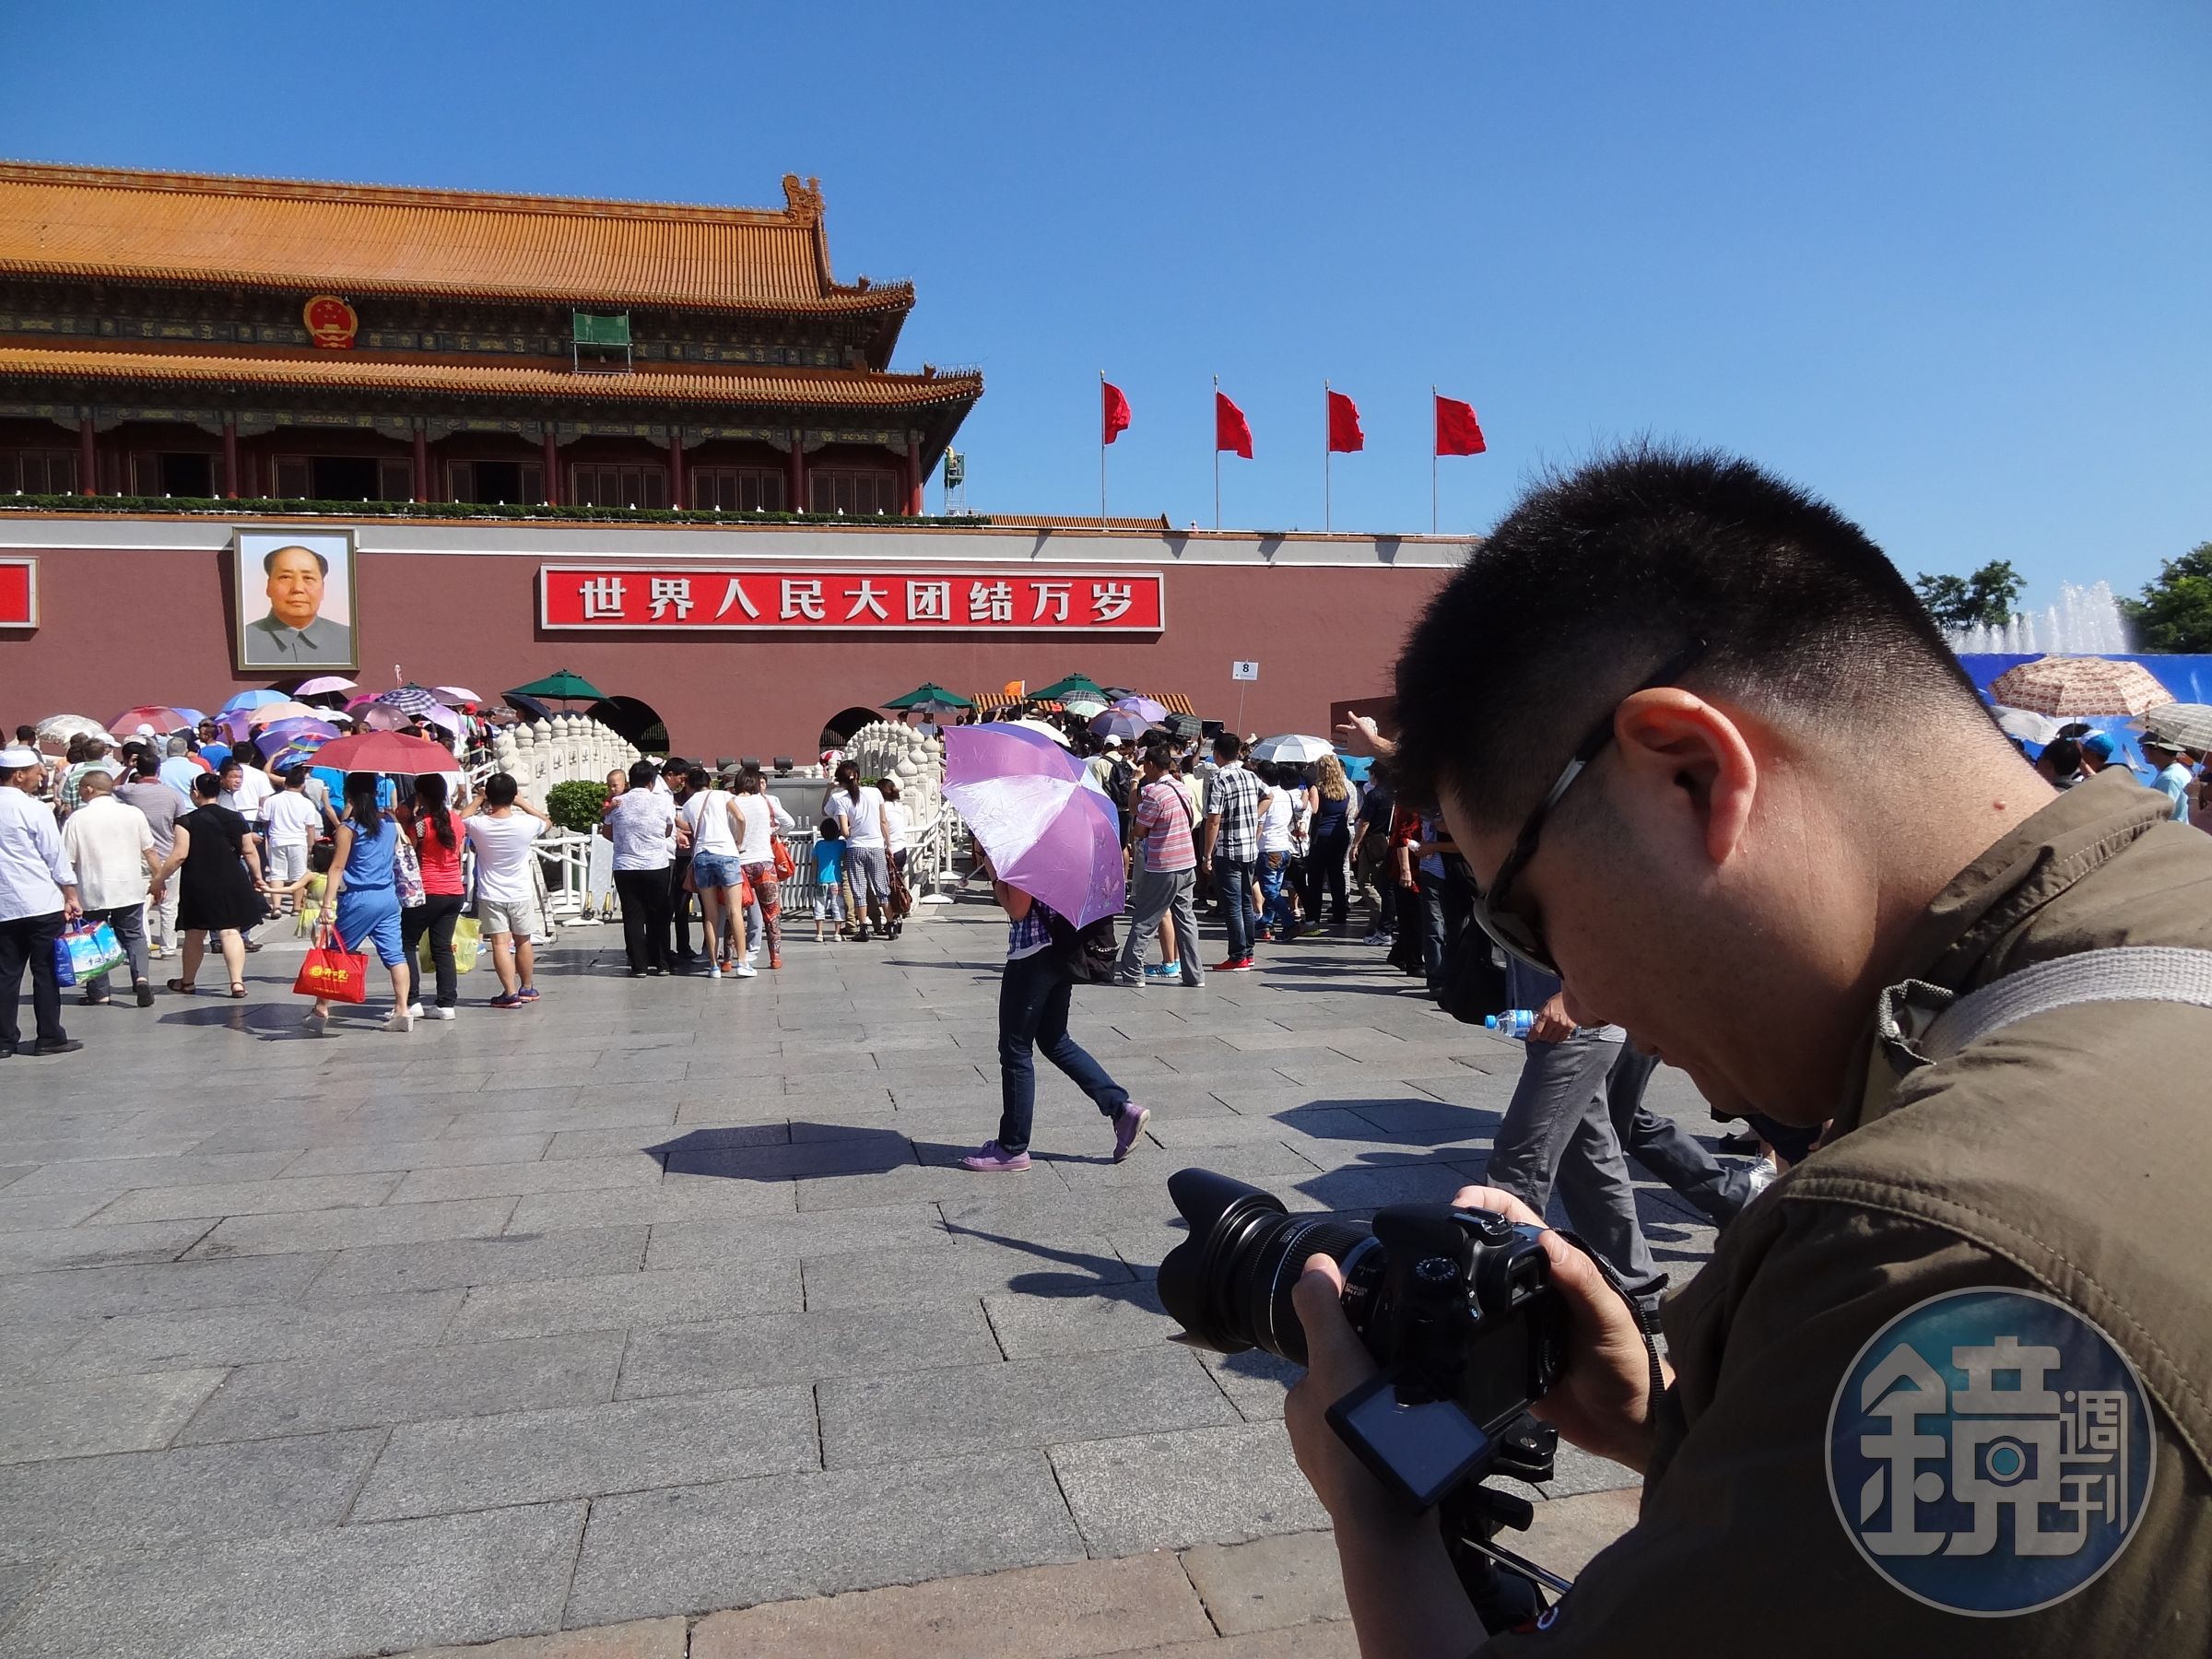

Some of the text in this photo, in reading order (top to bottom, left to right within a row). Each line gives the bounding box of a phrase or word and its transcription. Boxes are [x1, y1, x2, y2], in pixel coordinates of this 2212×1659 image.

[579, 577, 1133, 622] 世界人民大团结万岁
[1242, 664, 1249, 673] 8
